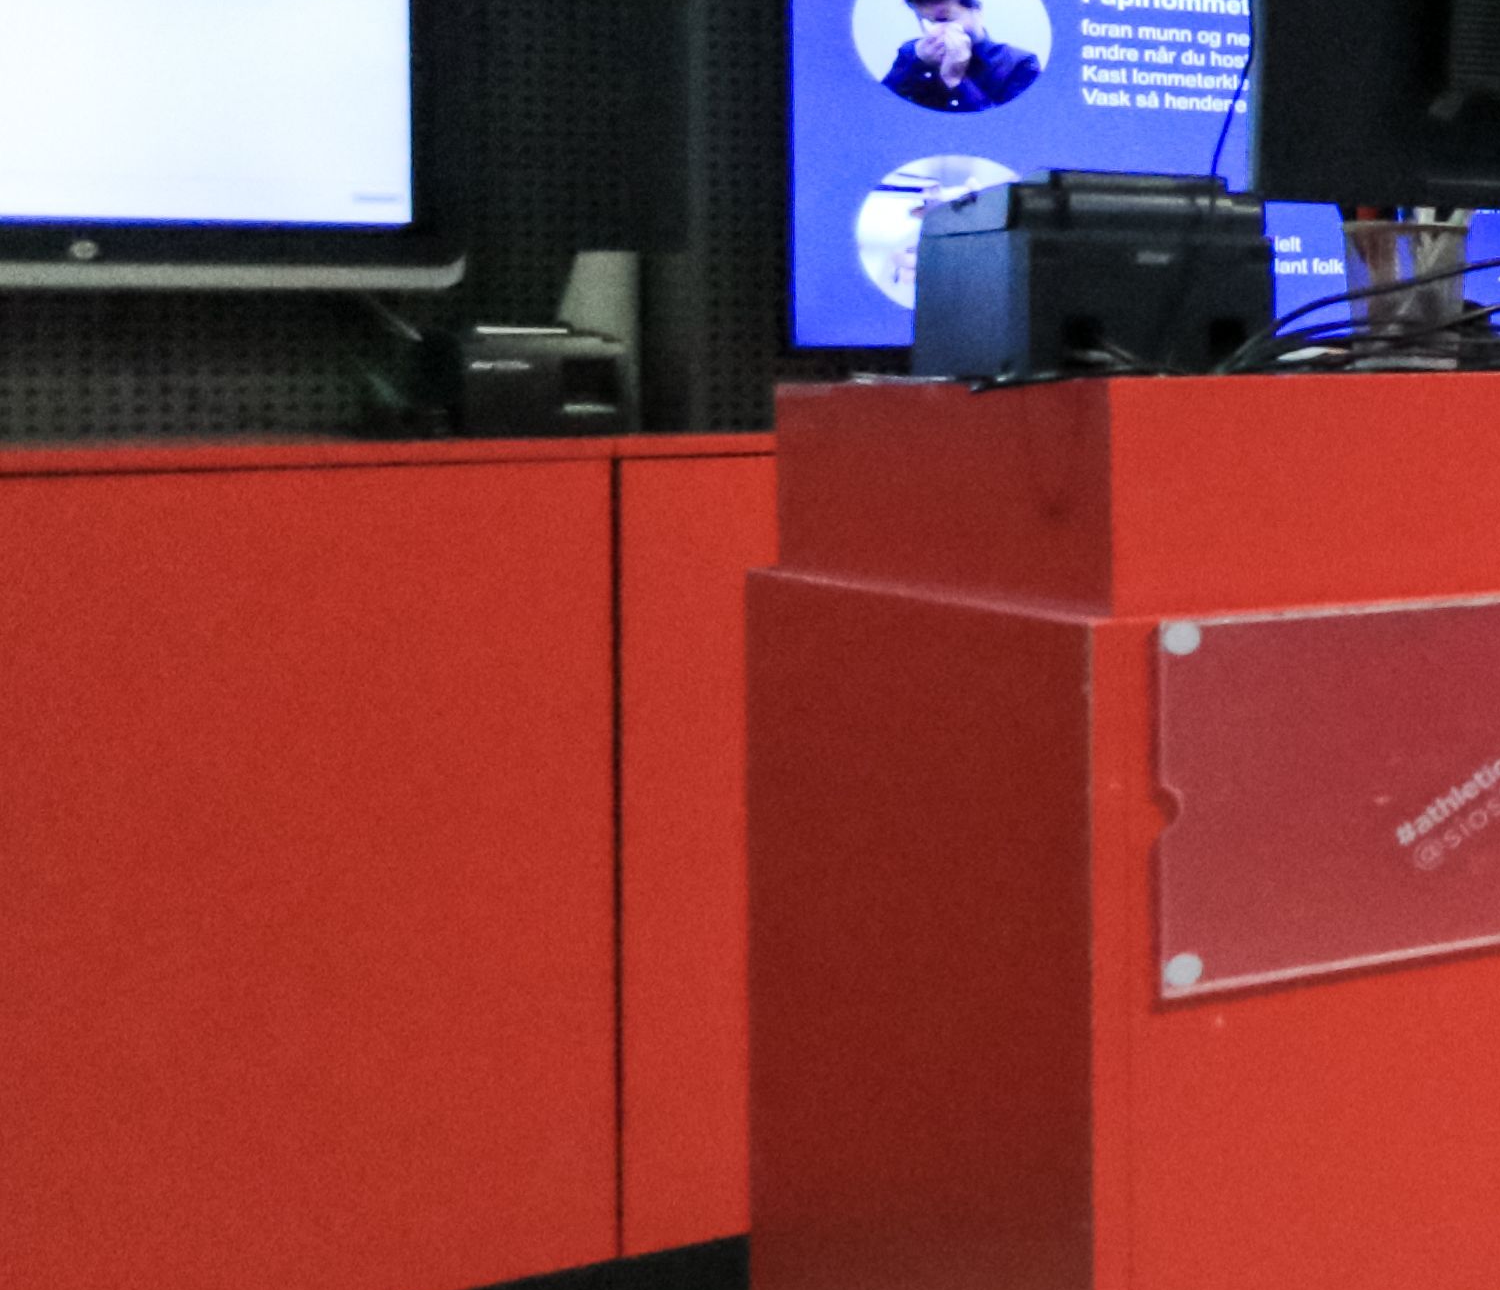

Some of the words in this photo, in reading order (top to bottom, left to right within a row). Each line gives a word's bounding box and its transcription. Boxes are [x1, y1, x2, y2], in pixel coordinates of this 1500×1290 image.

[1081, 18, 1133, 39] foran
[1137, 25, 1193, 44] munn
[1196, 29, 1222, 49] og
[1081, 43, 1139, 62] andre
[1144, 45, 1177, 65] når
[1181, 49, 1206, 67] du
[1081, 64, 1128, 84] Kast
[1081, 87, 1131, 107] Vask
[1135, 90, 1160, 108] så
[1274, 258, 1308, 275] lant
[1312, 258, 1344, 275] folk
